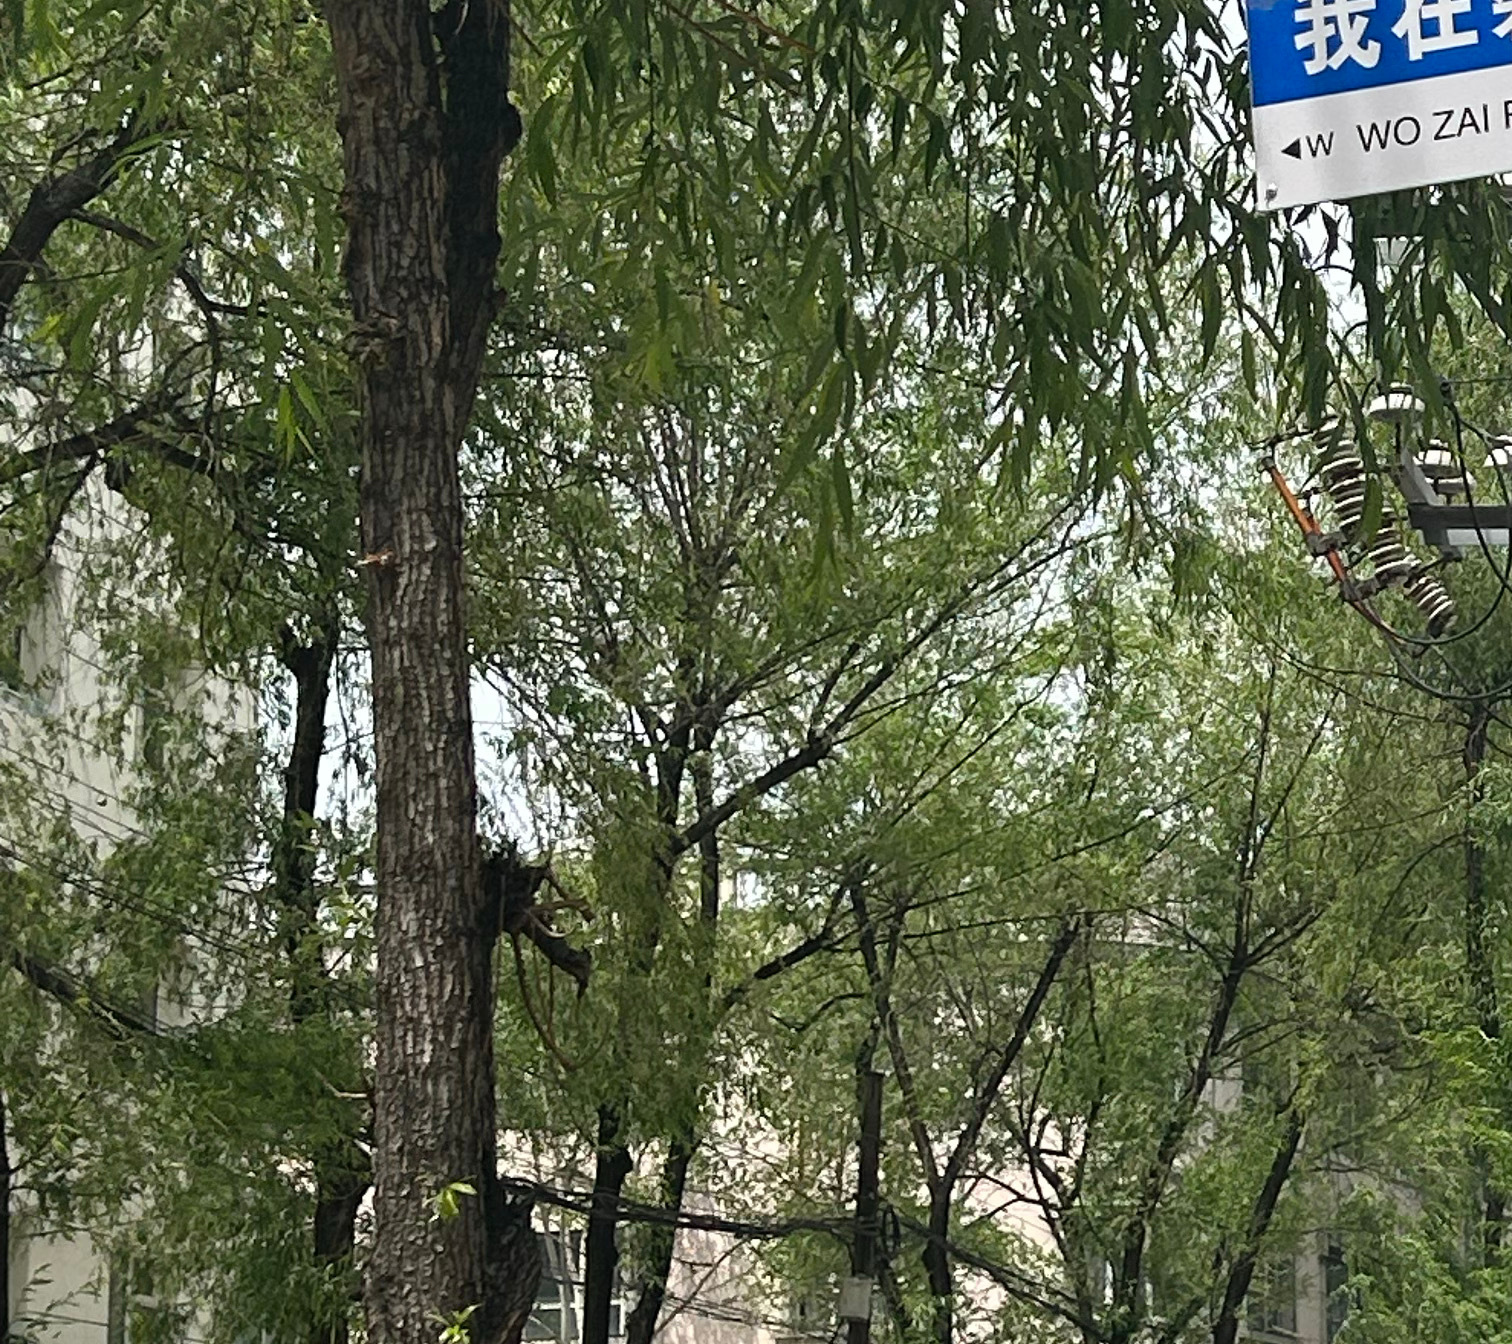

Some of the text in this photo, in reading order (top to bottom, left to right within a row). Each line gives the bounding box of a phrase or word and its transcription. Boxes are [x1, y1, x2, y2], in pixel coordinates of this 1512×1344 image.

[1305, 131, 1334, 157] W
[1356, 115, 1422, 153] WO
[1432, 103, 1491, 142] ZAI
